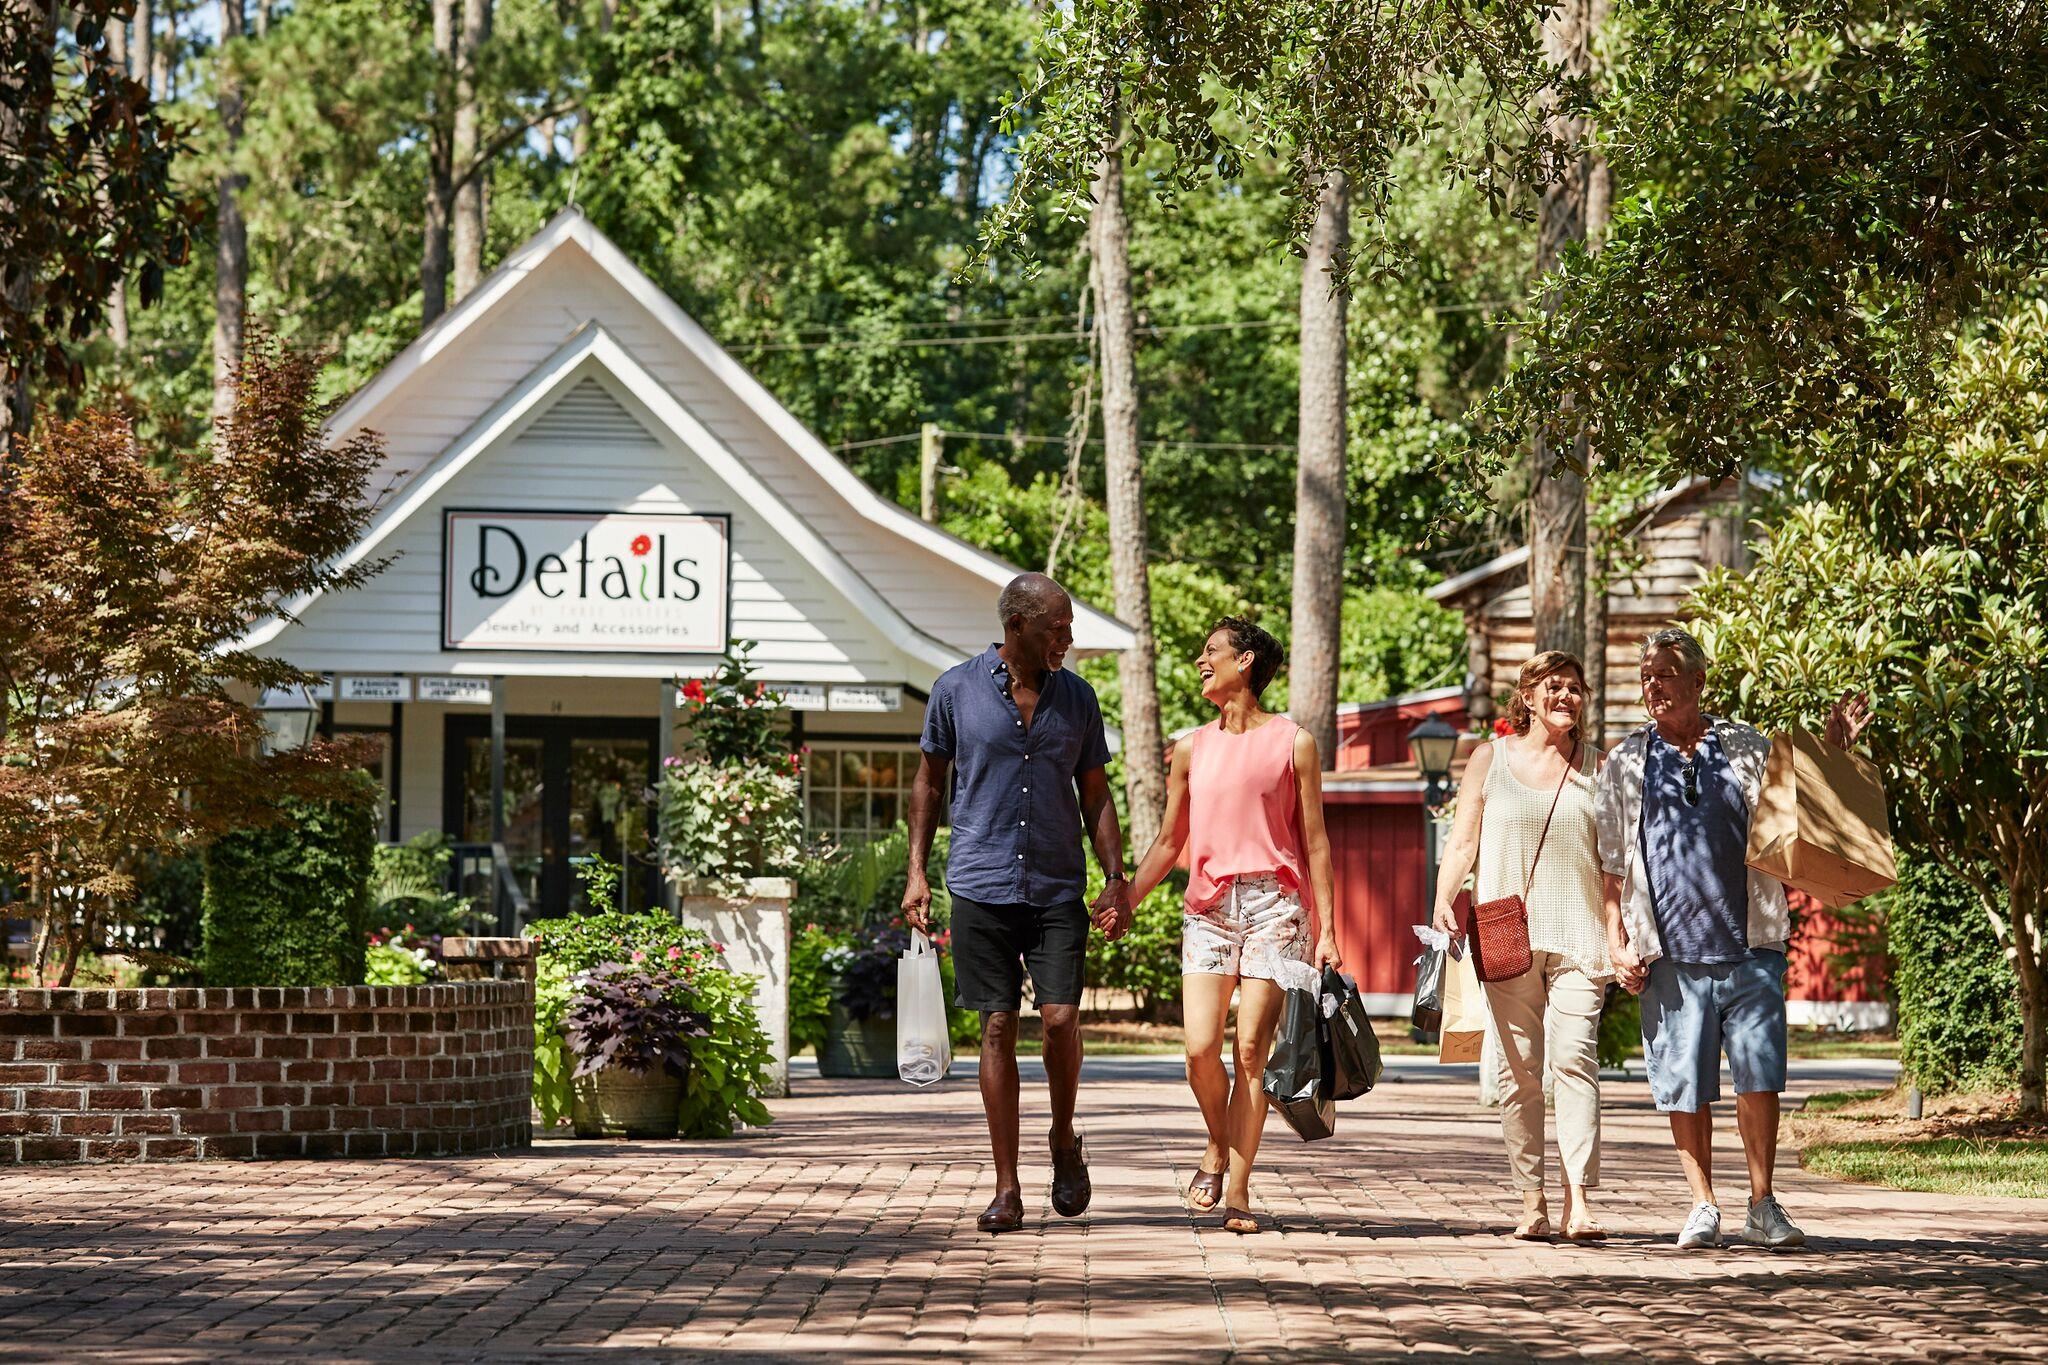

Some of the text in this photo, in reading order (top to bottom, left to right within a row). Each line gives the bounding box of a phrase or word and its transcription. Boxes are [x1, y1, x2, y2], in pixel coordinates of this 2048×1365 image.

[470, 525, 701, 601] Details
[485, 619, 689, 636] Jewelry and Accessories
[352, 680, 399, 688] FASHION
[352, 688, 399, 697] JEWELRY
